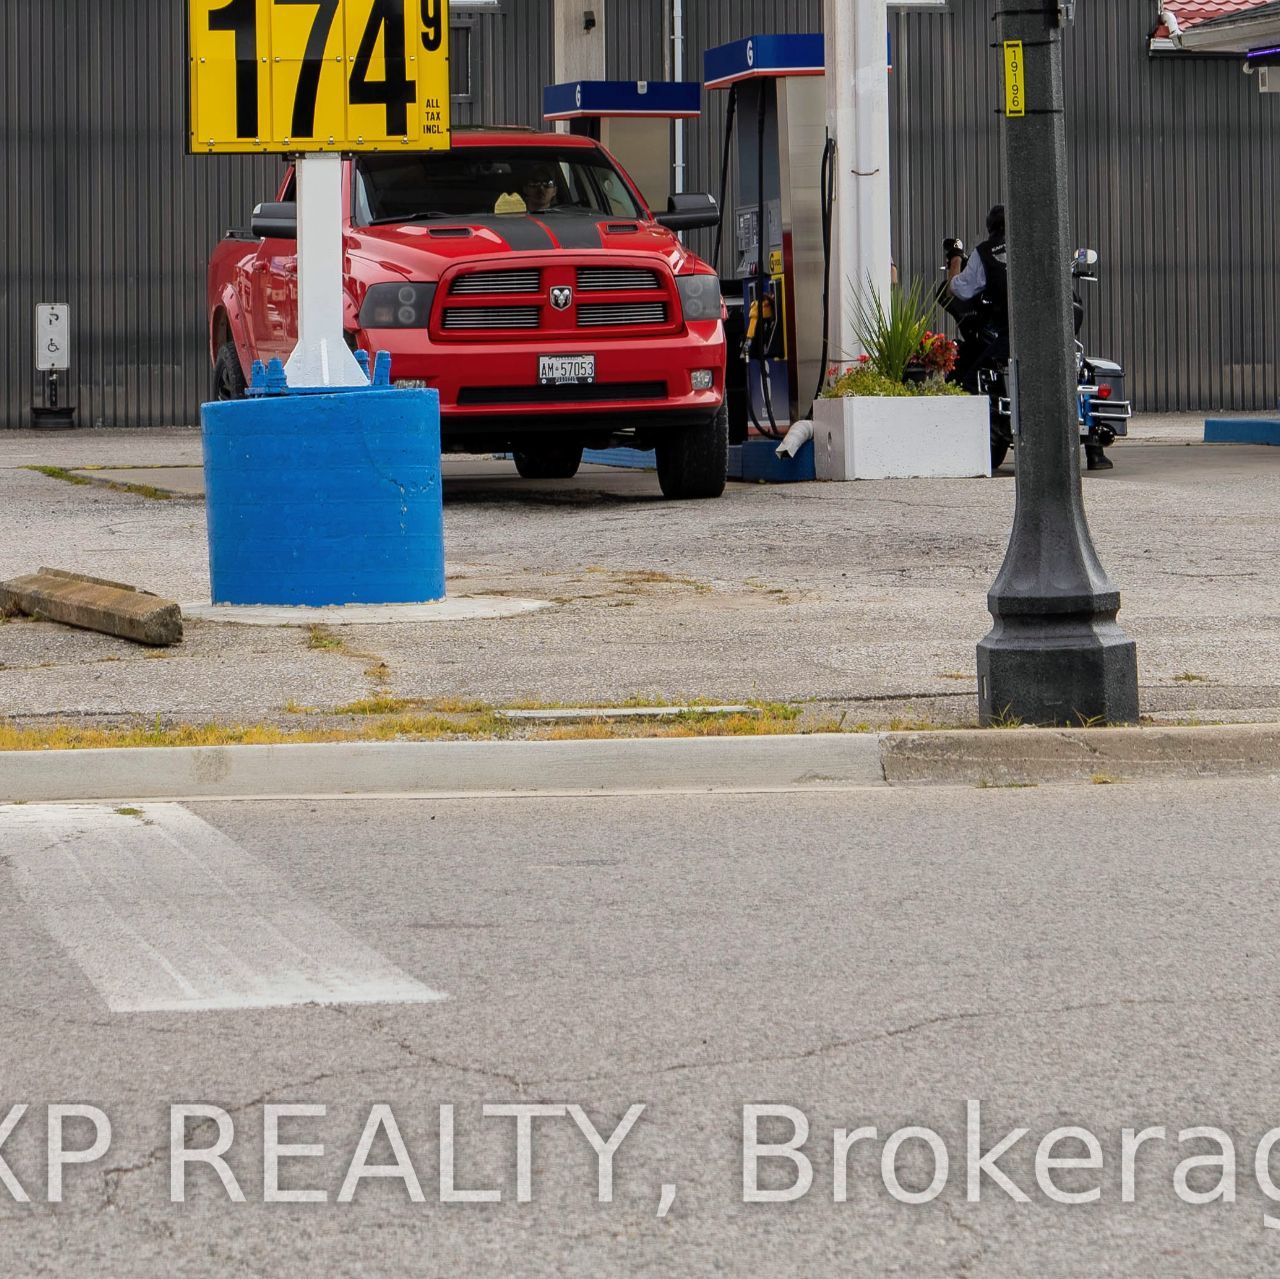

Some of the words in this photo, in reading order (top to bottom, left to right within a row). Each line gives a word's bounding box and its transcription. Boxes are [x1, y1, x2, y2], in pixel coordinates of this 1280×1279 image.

[1011, 50, 1019, 107] 19196
[426, 99, 440, 108] ALL
[425, 112, 441, 121] TAX
[423, 125, 444, 134] INCL.
[542, 363, 554, 377] AM
[561, 362, 594, 376] 57053
